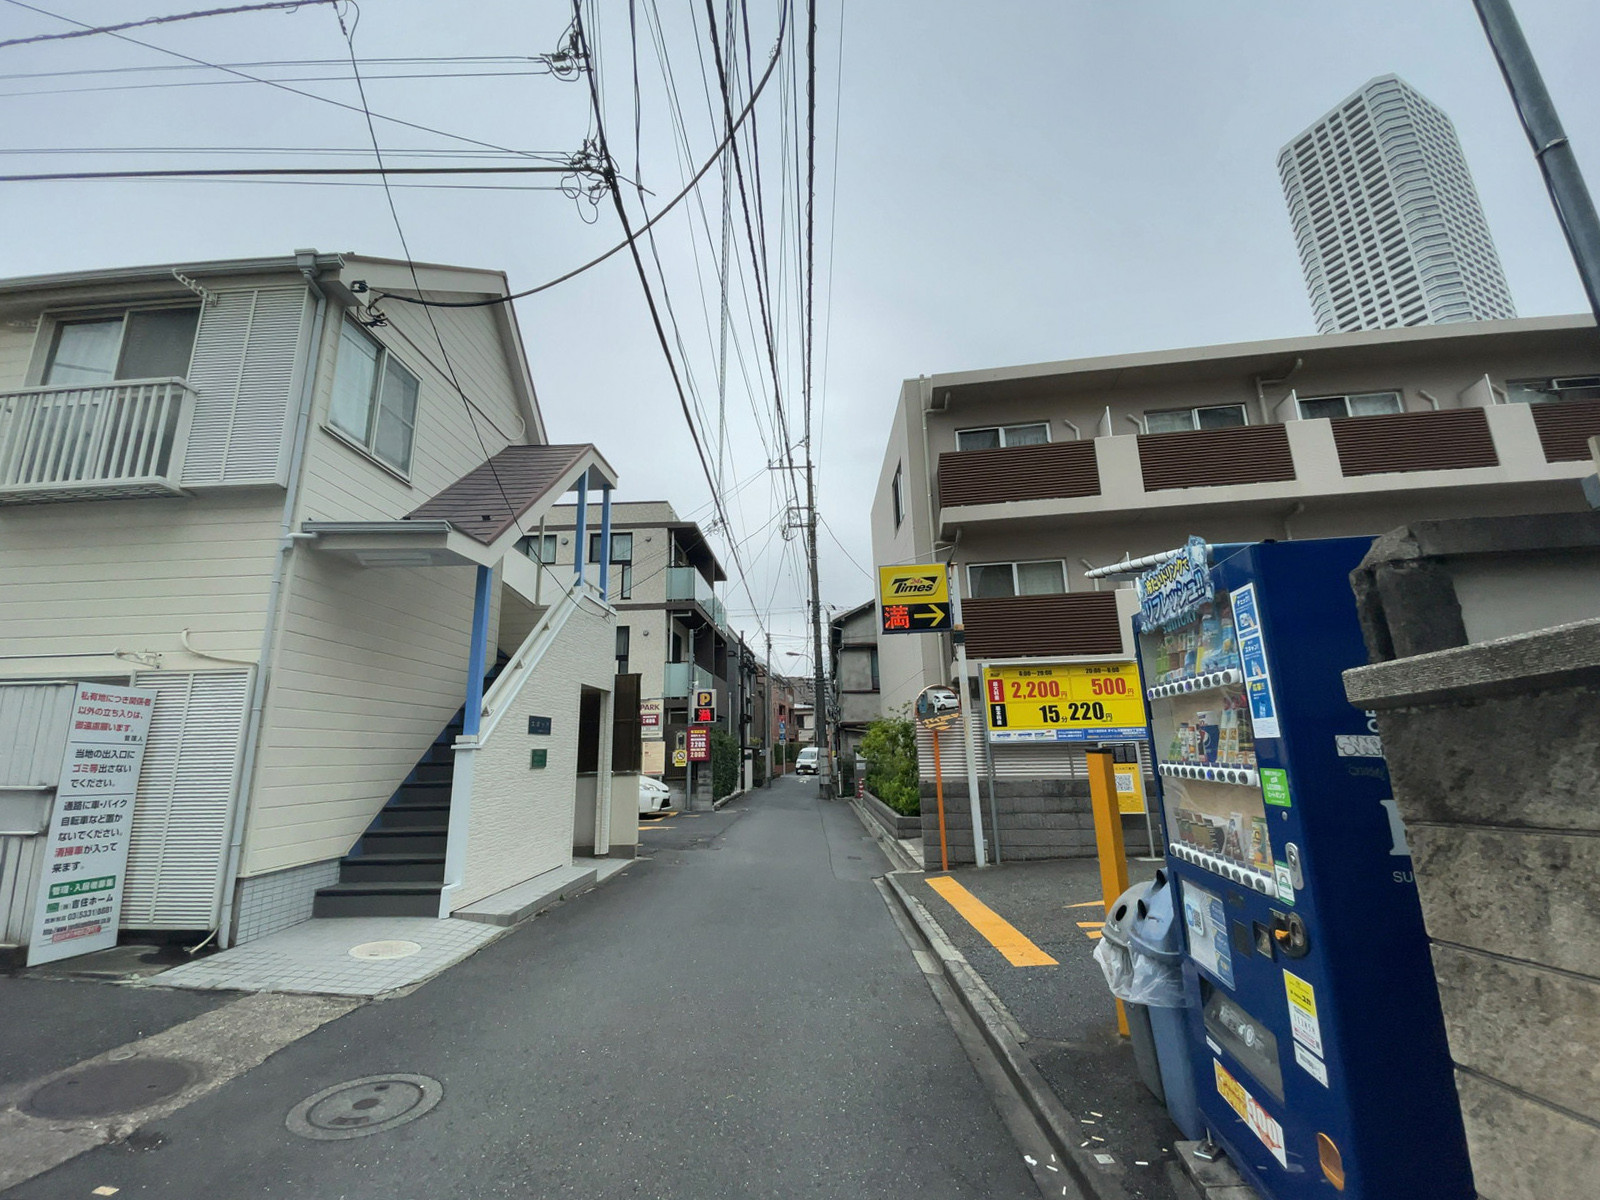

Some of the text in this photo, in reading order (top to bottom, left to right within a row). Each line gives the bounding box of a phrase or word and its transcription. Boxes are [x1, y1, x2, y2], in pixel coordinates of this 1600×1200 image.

[892, 579, 936, 594] Times
[884, 605, 910, 629] 満
[700, 693, 710, 705] P
[78, 706, 144, 719] 以外の立ち入りは、
[75, 749, 135, 759] 当地の出入口に
[72, 763, 131, 774] ゴミ等出さない
[63, 799, 128, 811] 通路に車・バイク
[61, 814, 123, 826] 自転車など置か
[52, 862, 84, 873] 来ます。
